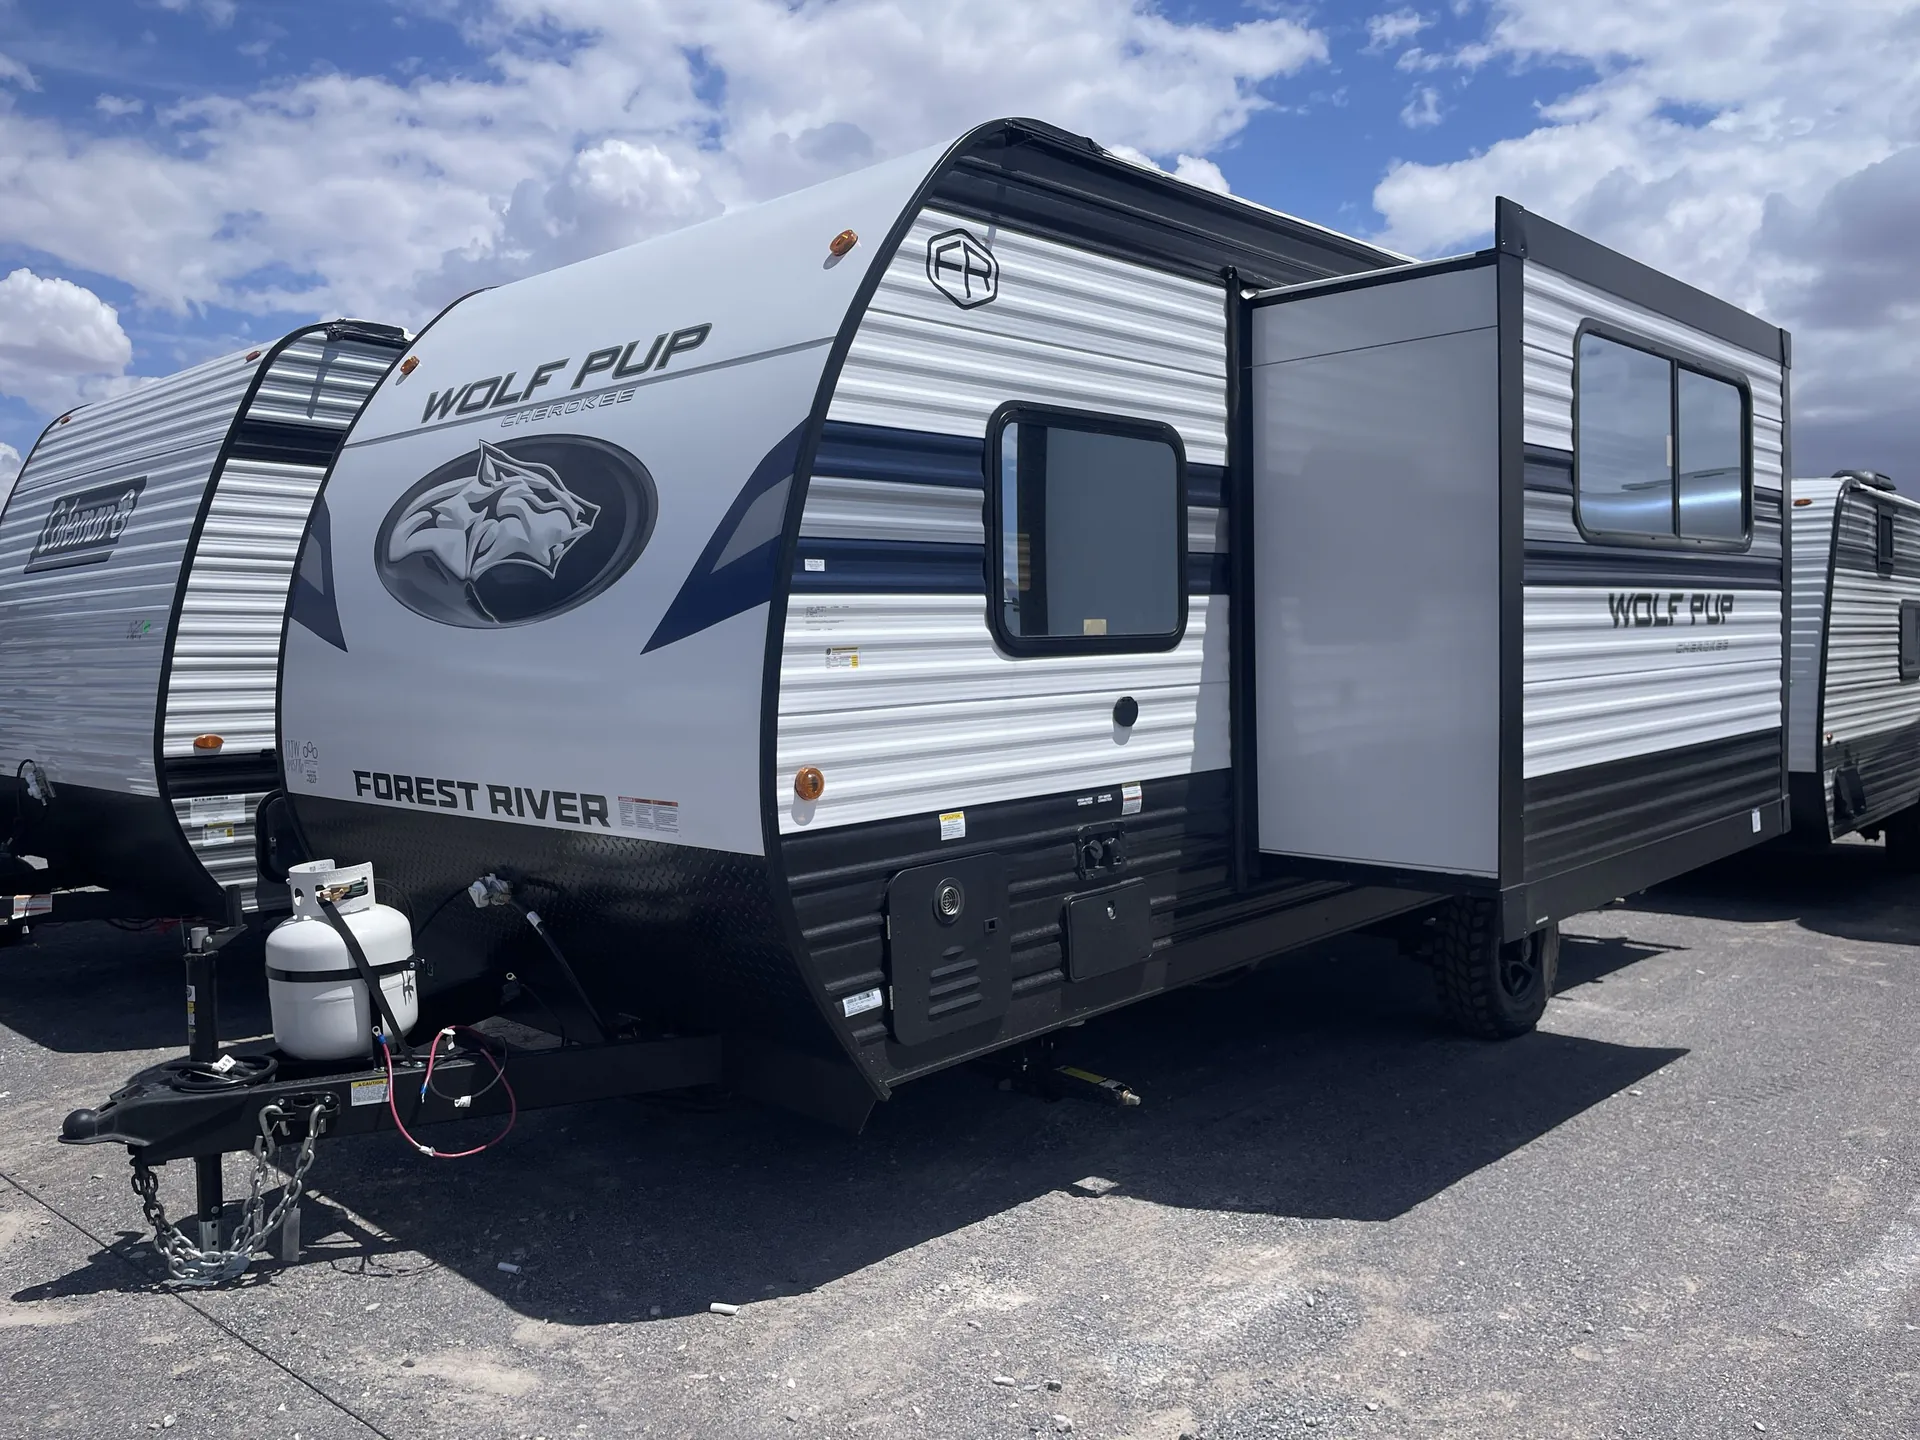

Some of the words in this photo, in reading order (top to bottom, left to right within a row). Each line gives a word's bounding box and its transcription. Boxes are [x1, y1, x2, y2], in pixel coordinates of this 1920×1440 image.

[421, 358, 570, 424] WOLF
[570, 322, 713, 391] PUP
[500, 387, 636, 427] CHEROKEE
[1608, 593, 1684, 629] WOLF
[1690, 593, 1734, 626] PUP
[353, 770, 479, 811] FOREST
[486, 784, 611, 828] RIVER
